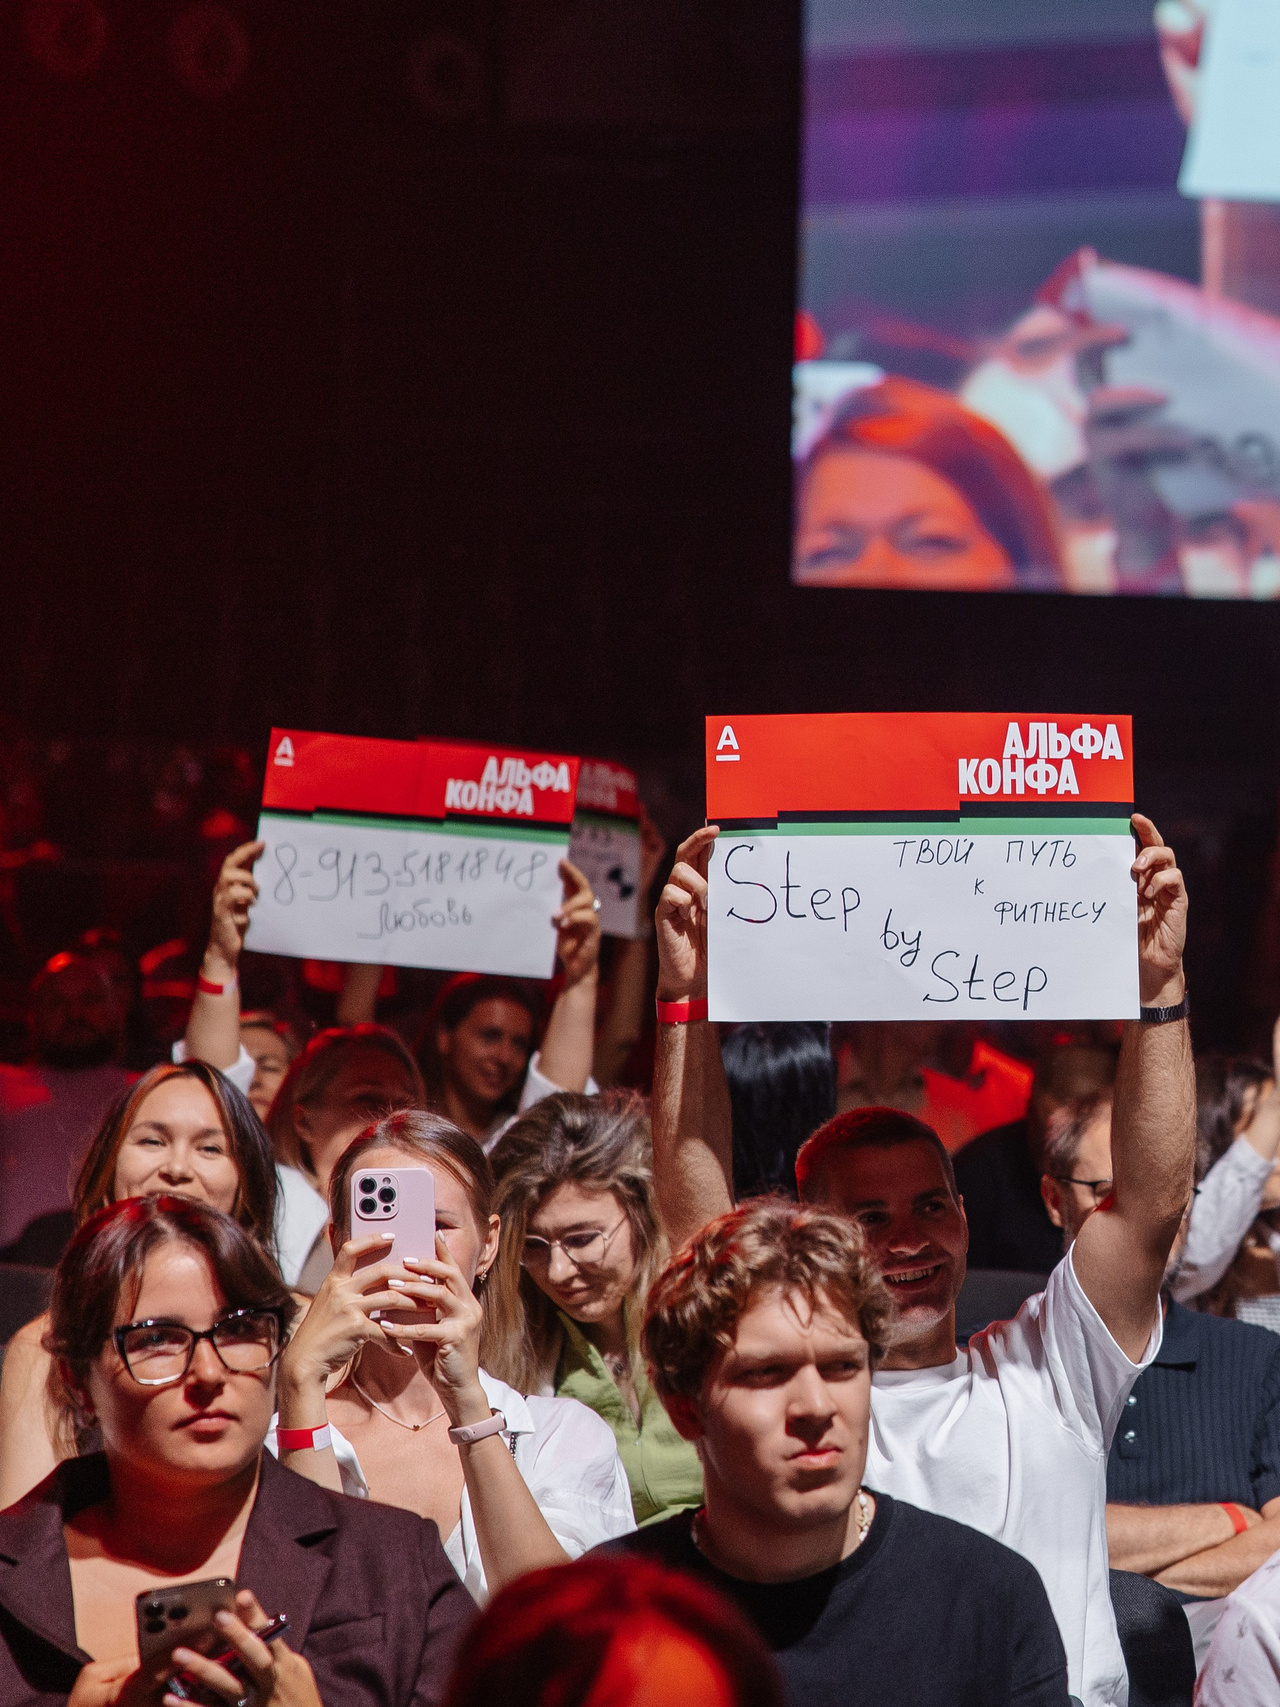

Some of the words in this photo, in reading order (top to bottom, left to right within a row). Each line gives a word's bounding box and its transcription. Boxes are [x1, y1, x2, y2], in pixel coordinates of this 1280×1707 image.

[1003, 721, 1124, 760] АЛЬФА
[481, 755, 571, 793] АЛЬФА
[958, 758, 1080, 795] КОНФА
[444, 778, 534, 815] КОНФА
[893, 838, 974, 868] ТВОЙ
[1006, 840, 1077, 868] ПУТЬ
[724, 844, 861, 932] Step
[993, 900, 1107, 926] ФИТНЕСУ
[879, 908, 922, 968] by
[922, 950, 1048, 1011] Step
